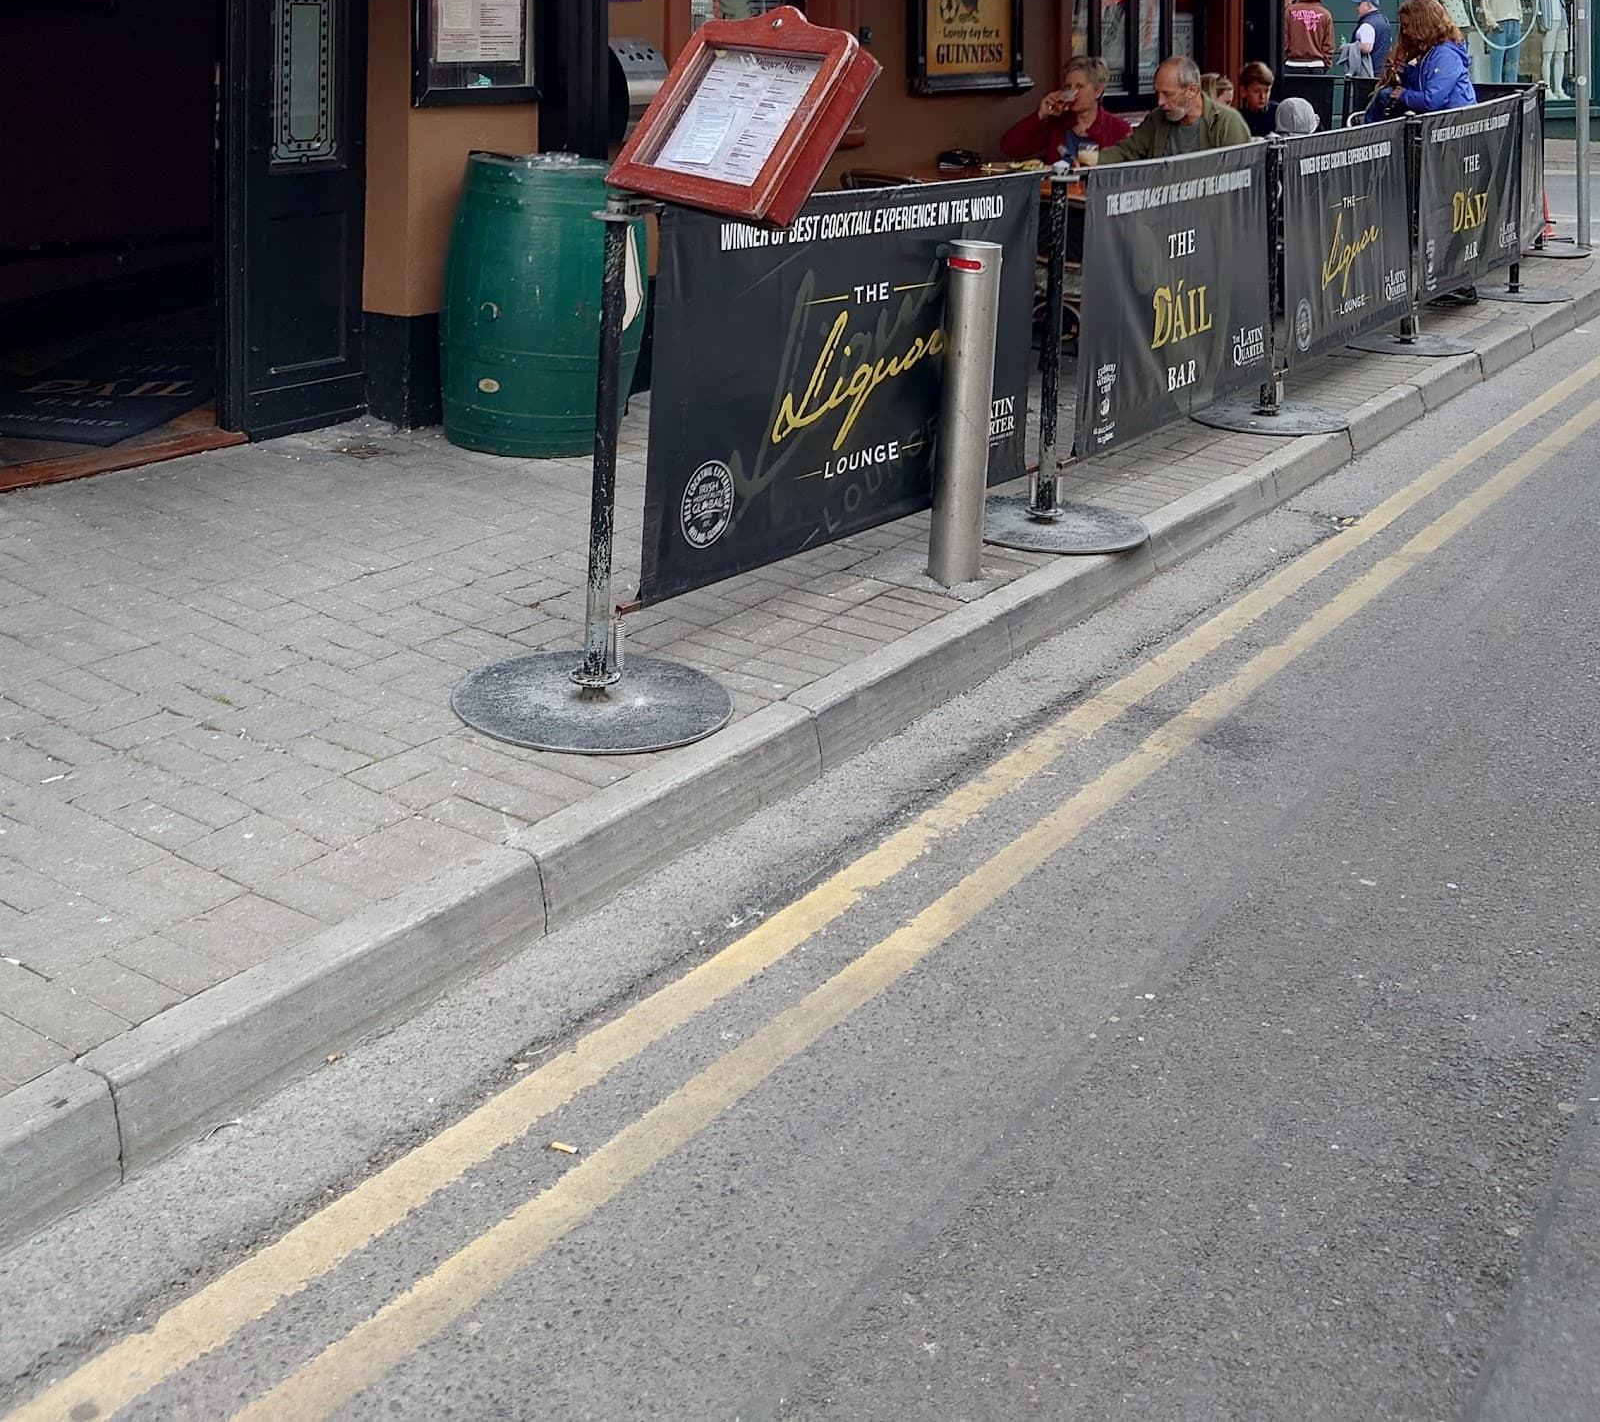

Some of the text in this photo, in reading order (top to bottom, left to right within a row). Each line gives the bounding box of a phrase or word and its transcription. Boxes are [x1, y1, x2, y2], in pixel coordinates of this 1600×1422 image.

[936, 43, 1003, 65] GUINNESS
[1464, 153, 1480, 174] THE
[1342, 194, 1355, 209] THE
[720, 222, 769, 251] WINNER
[788, 214, 821, 243] BEST
[820, 210, 873, 240] COCKTAIL
[874, 203, 938, 235] EXPERIENCE
[938, 201, 950, 225] IN
[950, 198, 971, 223] THE
[971, 195, 1004, 221] WORLD
[1168, 229, 1196, 259] THE
[1321, 212, 1379, 298] Liquor
[1389, 268, 1406, 287] LATIN
[853, 281, 890, 305] THE
[1339, 294, 1366, 315] LOUNGE
[1151, 279, 1213, 349] DÁIL
[1240, 326, 1263, 347] LATIN
[1233, 341, 1264, 366] QUARTER
[772, 310, 944, 451] Liquor
[1167, 359, 1196, 393] BAR
[823, 440, 900, 479] LOUNGE
